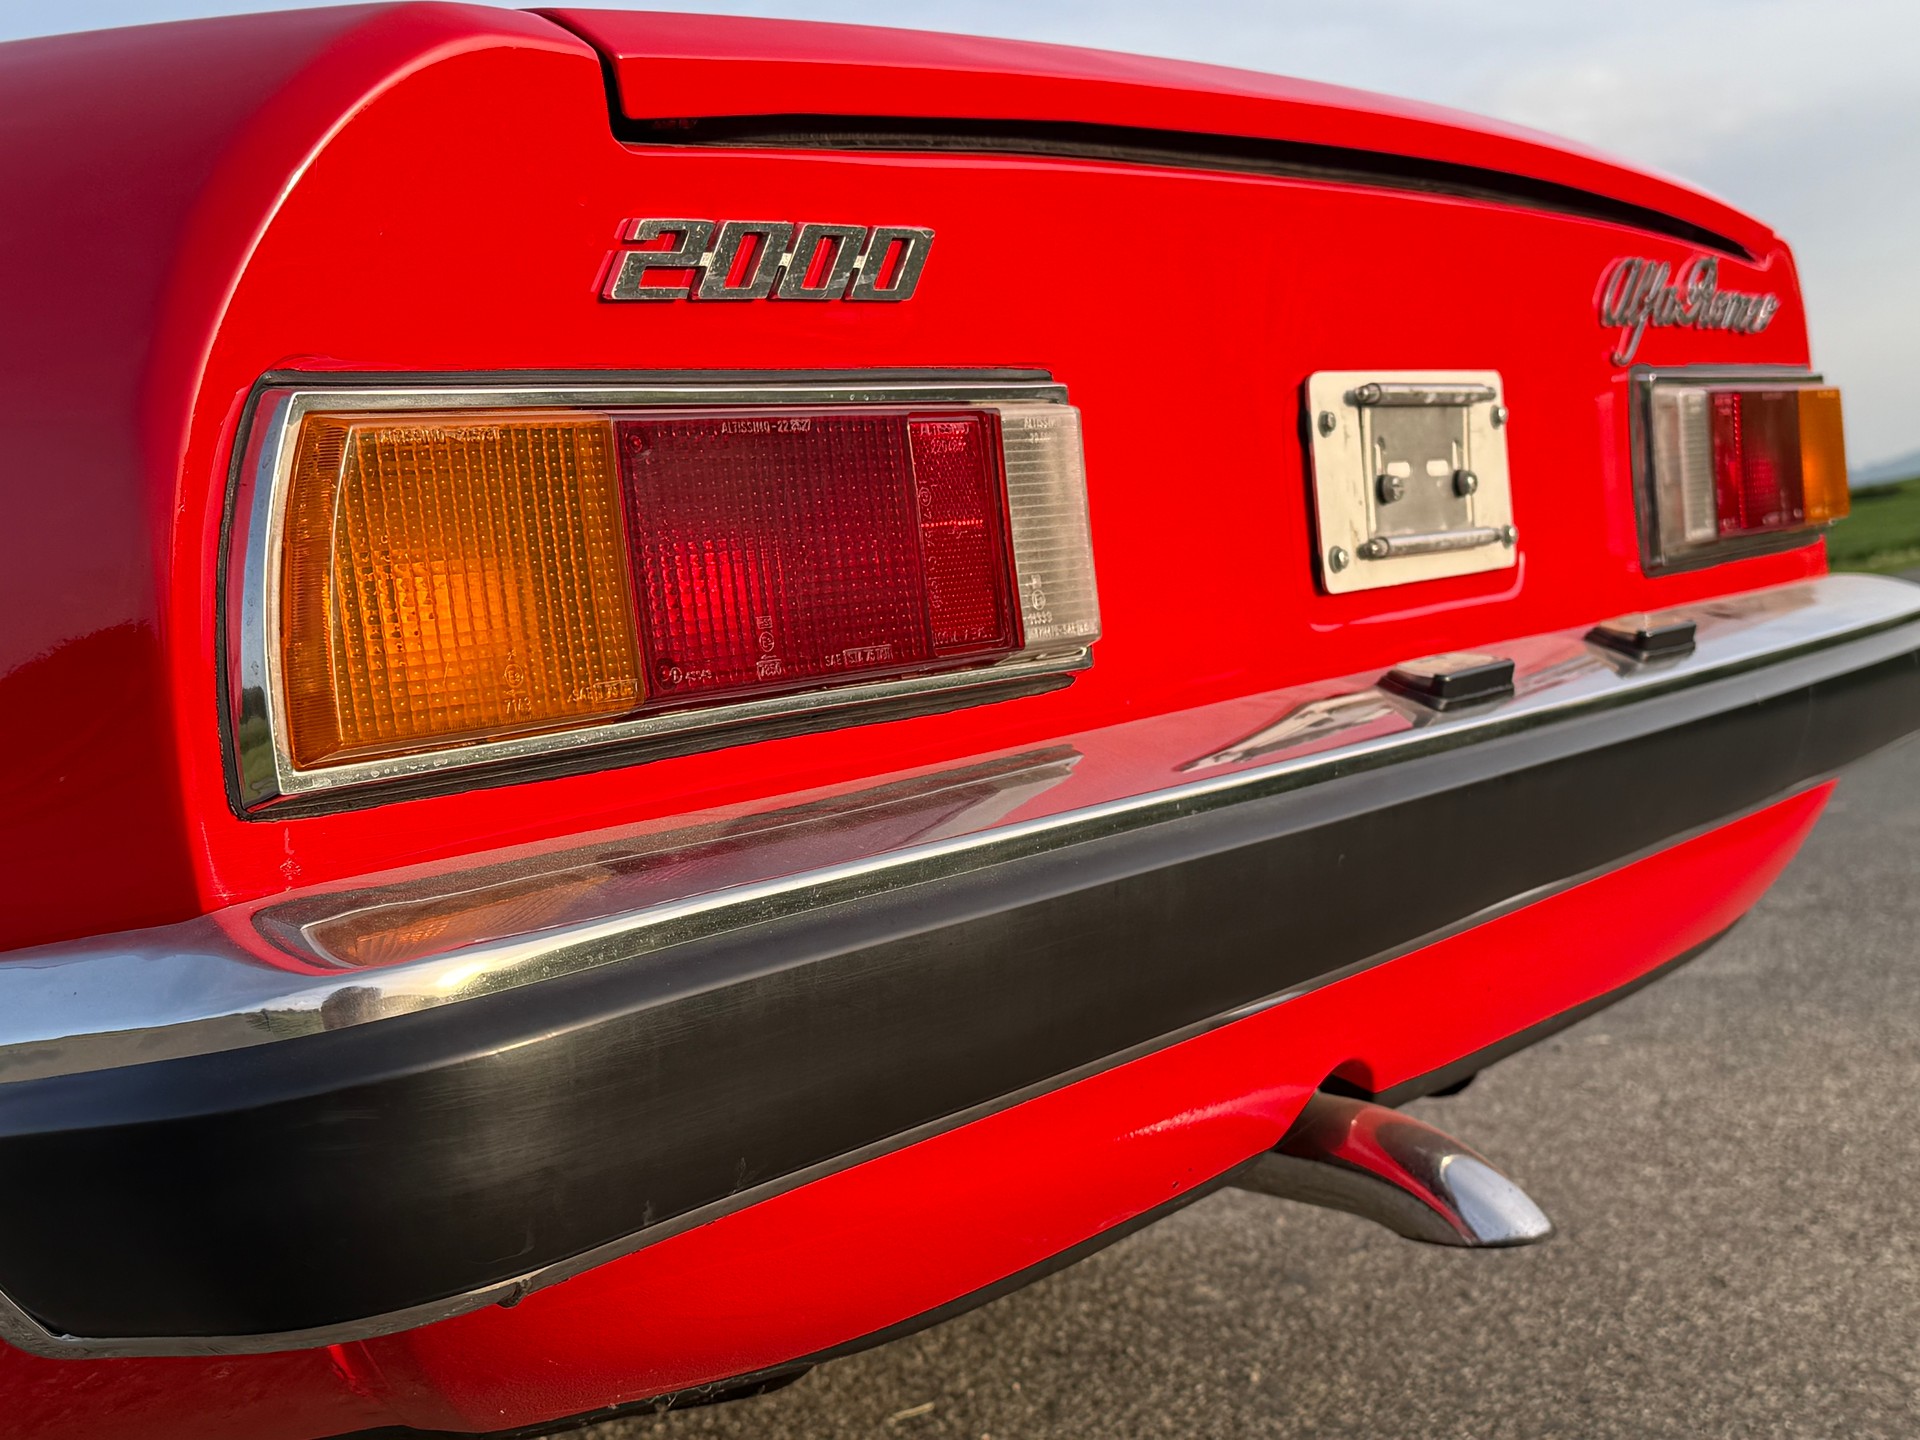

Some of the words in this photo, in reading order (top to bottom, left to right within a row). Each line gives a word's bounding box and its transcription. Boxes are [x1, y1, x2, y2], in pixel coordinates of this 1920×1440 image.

[600, 217, 936, 302] 2000
[1600, 256, 1681, 366] Alfa
[1676, 255, 1779, 335] Romeo
